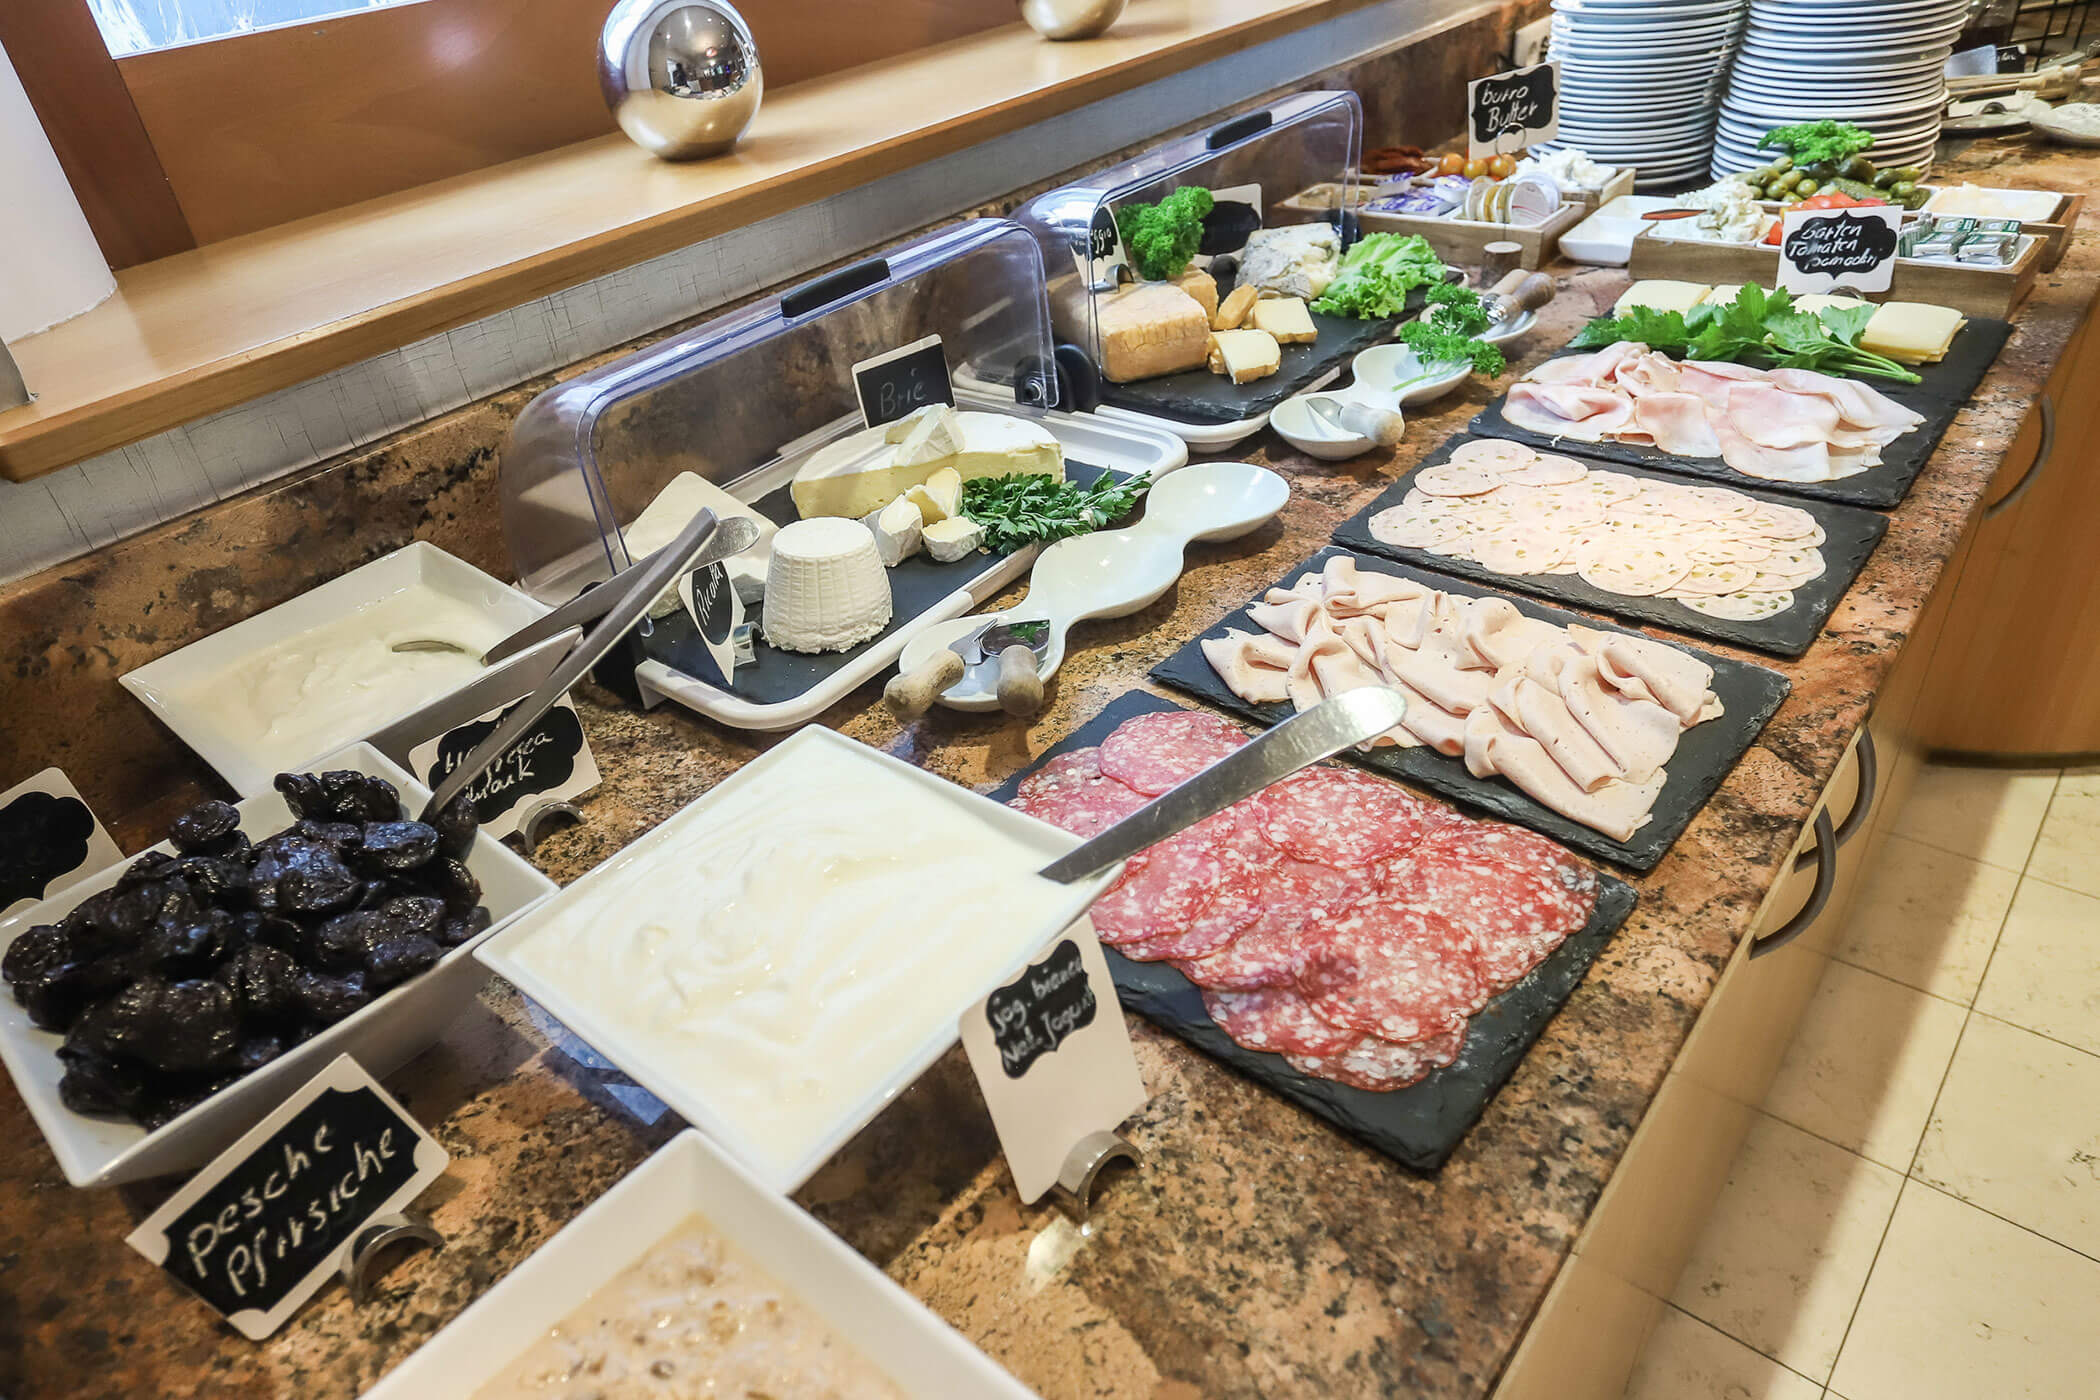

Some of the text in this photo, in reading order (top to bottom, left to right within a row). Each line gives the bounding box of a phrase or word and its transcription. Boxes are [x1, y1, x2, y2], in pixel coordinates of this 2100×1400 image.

[1481, 83, 1528, 105] burro
[1485, 101, 1538, 132] Butter
[1801, 219, 1862, 240] Garten
